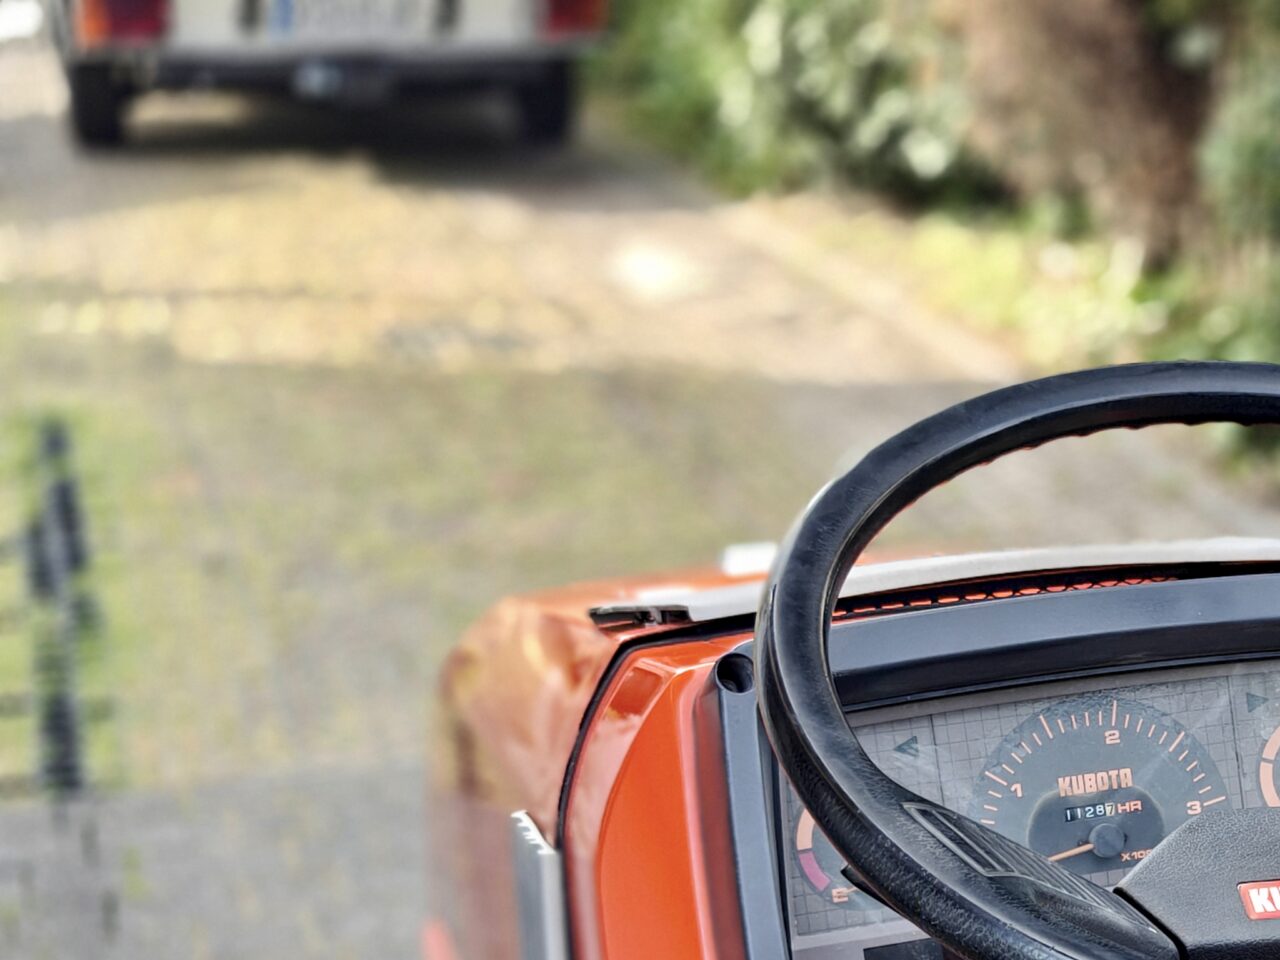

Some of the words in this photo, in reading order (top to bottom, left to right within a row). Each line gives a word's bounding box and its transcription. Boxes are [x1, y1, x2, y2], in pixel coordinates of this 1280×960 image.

[1105, 730, 1121, 745] 2
[1057, 767, 1133, 797] KUBOTA
[1010, 783, 1024, 798] 1
[1066, 803, 1115, 821] 11287
[1117, 800, 1142, 814] HR
[1186, 801, 1202, 815] 3
[831, 887, 849, 903] E
